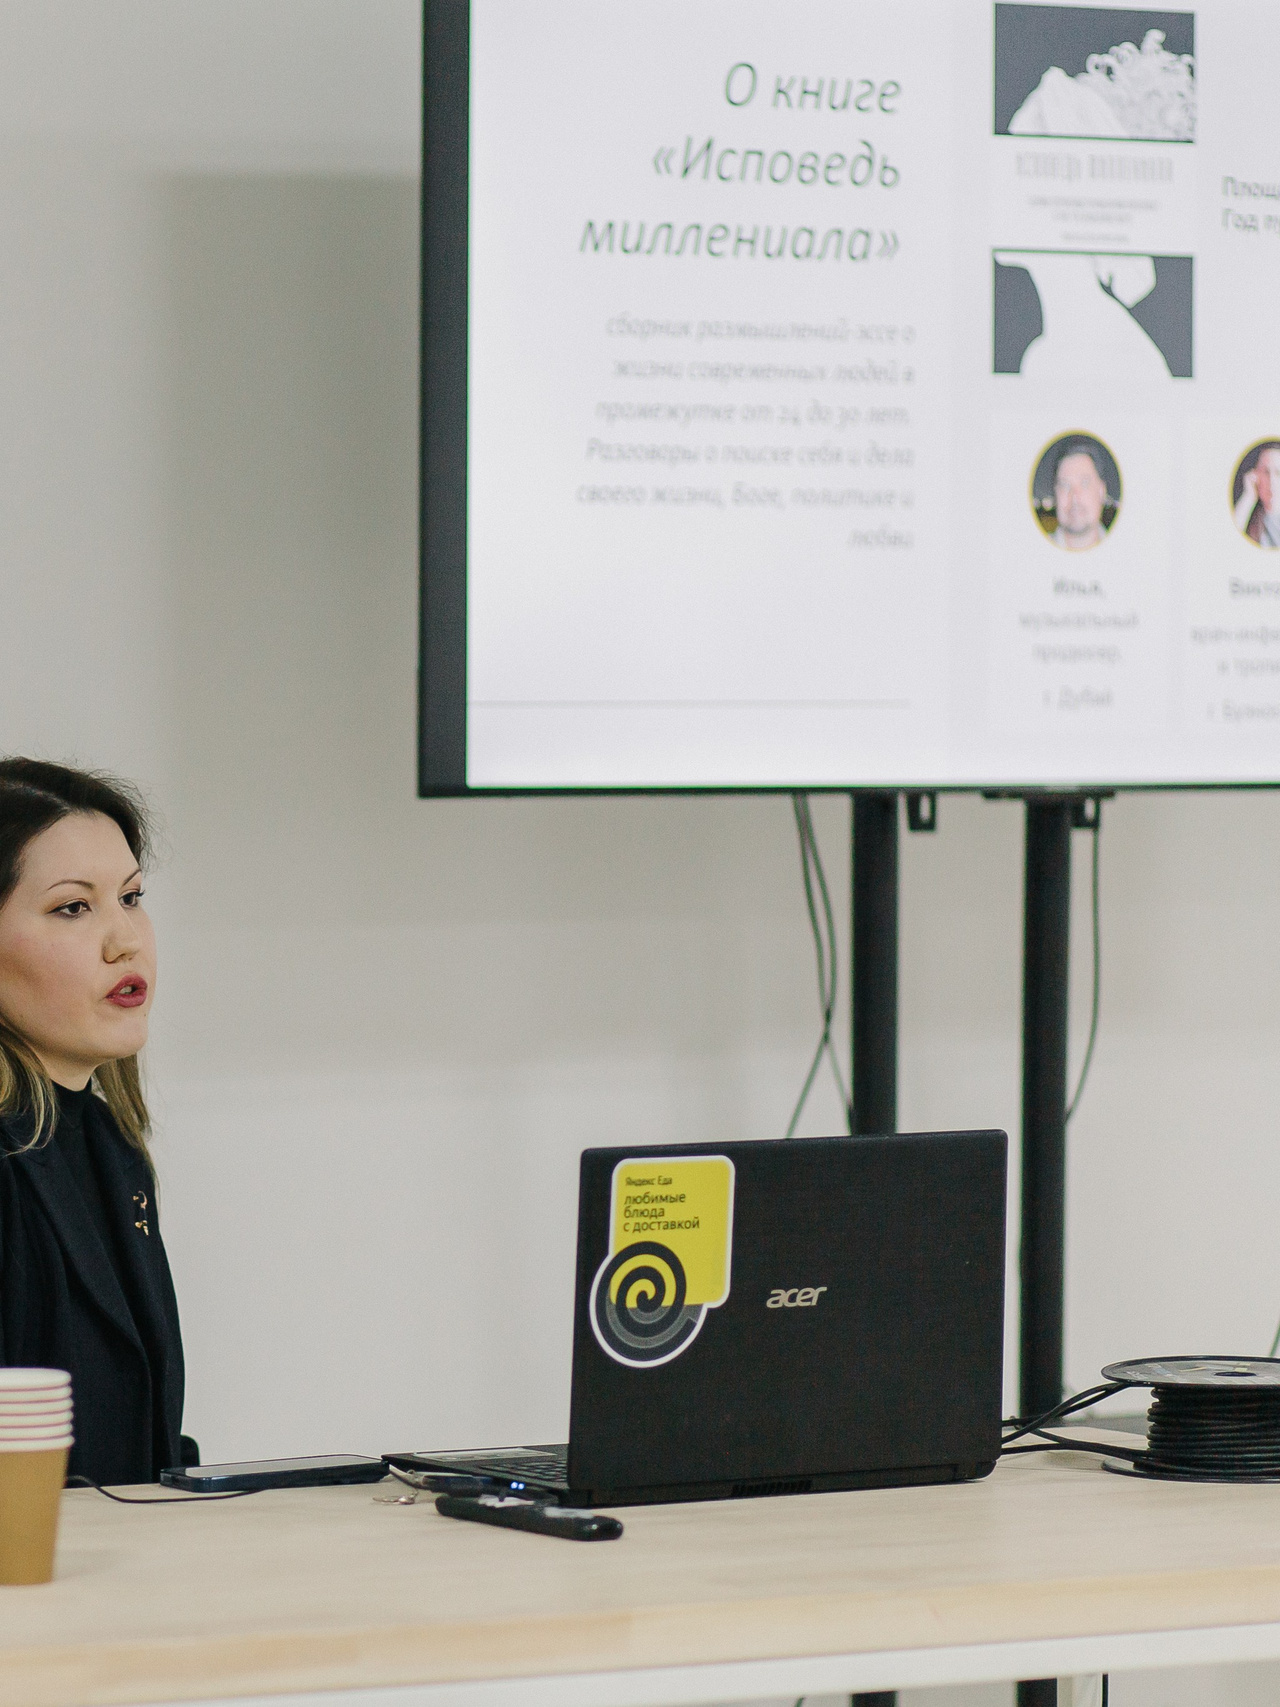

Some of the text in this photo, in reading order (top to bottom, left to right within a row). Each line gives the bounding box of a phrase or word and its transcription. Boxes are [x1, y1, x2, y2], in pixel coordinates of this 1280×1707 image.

[724, 62, 902, 113] О книге
[652, 136, 900, 188] «Исповедь
[578, 219, 901, 261] миллениала»
[624, 1191, 686, 1205] любимые
[623, 1206, 665, 1219] блюда
[623, 1216, 700, 1233] с доставкой
[766, 1286, 828, 1309] acer
